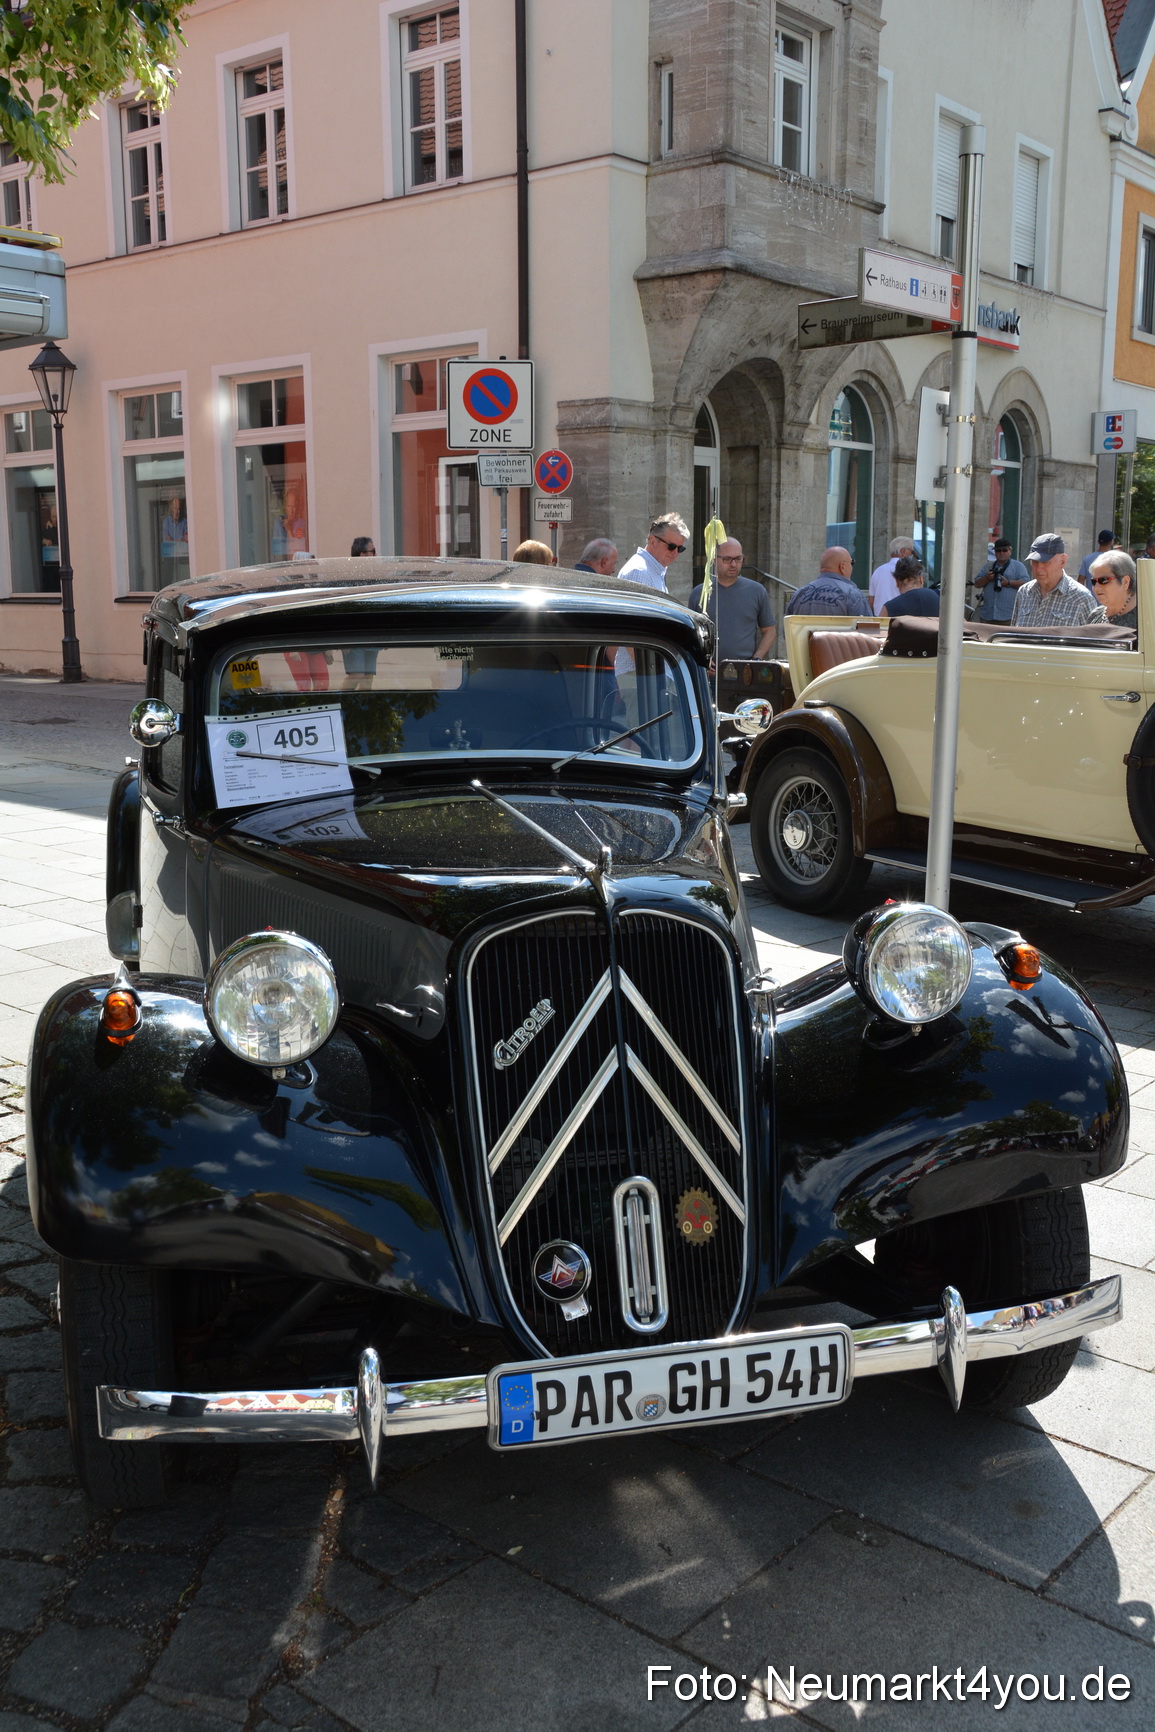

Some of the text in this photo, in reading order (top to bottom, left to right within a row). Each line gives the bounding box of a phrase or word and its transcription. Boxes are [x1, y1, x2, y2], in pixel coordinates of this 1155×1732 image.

[880, 273, 907, 292] Rathaus
[821, 311, 903, 329] Brauereimuseum
[978, 300, 1020, 336] nsbank
[470, 429, 512, 443] ZONE
[486, 458, 526, 467] Bewohner
[499, 474, 513, 483] frei
[538, 501, 569, 510] Feuerwehr-
[543, 510, 563, 519] zufahrt
[231, 661, 259, 673] ADAC
[274, 725, 319, 749] 405
[535, 1370, 634, 1432] PAR
[668, 1357, 731, 1414] GH
[746, 1343, 838, 1404] 54H
[511, 1419, 524, 1433] D
